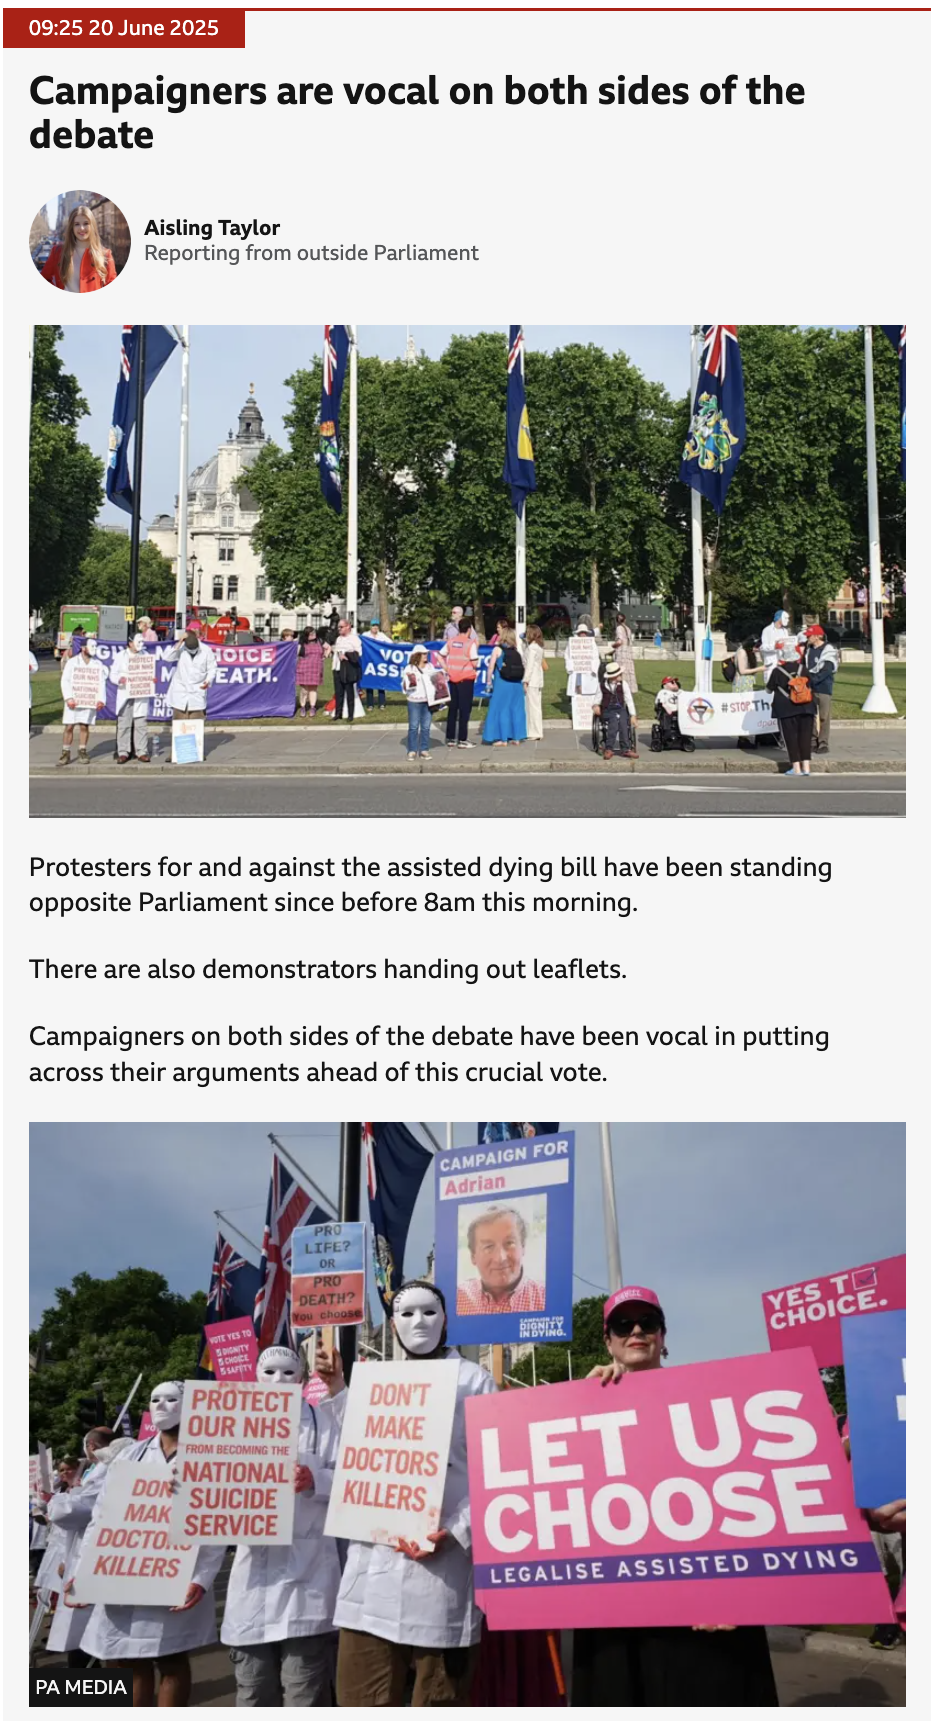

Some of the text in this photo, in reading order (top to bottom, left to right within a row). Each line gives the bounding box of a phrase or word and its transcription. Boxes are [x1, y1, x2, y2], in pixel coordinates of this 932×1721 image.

[29, 20, 218, 36] 09:25 20 June 2025
[30, 74, 805, 113] Campaigners are vocal on both sides of the
[30, 119, 153, 149] debate
[144, 219, 280, 240] Aisling Taylor
[145, 244, 479, 265] Reporting from outside Parliament
[213, 648, 273, 662] HOICE
[380, 649, 413, 664] VOT
[215, 667, 278, 684] EATH.
[31, 856, 831, 882] Protesters for and against the assisted dying bill have been standing
[30, 891, 637, 917] opposite Parliament since before 8am this morning.
[29, 958, 626, 984] There are also demonstrators handing out leaflets.
[30, 1025, 828, 1051] Campaigners on both sides of the debate have been vocal in putting
[30, 1061, 607, 1087] across their arguments ahead of this crucial vote.
[440, 1140, 568, 1172] CAMPAIGN FOR
[445, 1175, 506, 1196] Adrian
[314, 1225, 342, 1237] PRO
[305, 1240, 351, 1254] LIFE?
[319, 1258, 336, 1269] OR
[313, 1275, 342, 1289] PRO
[299, 1292, 356, 1307] DEATH?
[767, 1283, 821, 1311] YES
[320, 1309, 363, 1320] choose
[770, 1289, 888, 1330] CHOICE.
[209, 1329, 252, 1345] VOTE YES TO
[519, 1321, 564, 1330] DIGNITY
[519, 1328, 567, 1338] IN DYING.
[221, 1344, 250, 1355] DIGNITY
[224, 1354, 249, 1365] CHOICE
[191, 1389, 294, 1413] PROTECT
[369, 1383, 431, 1407] DON'T
[187, 1415, 291, 1439] OUR NHS
[365, 1415, 426, 1441] MAKE
[185, 1444, 290, 1456] FROM BECOMING THE
[480, 1390, 818, 1489] LET US
[182, 1461, 289, 1484] NATIONAL
[342, 1446, 439, 1477] DOCTORS
[189, 1487, 278, 1510] SUICIDE
[342, 1479, 427, 1513] KILLERS
[124, 1503, 172, 1524] MAK
[484, 1464, 848, 1553] CHOOSE
[184, 1514, 278, 1536] SERVICE
[93, 1555, 182, 1579] KILLERS
[490, 1548, 859, 1584] LEGALISE ASSISTED DYING
